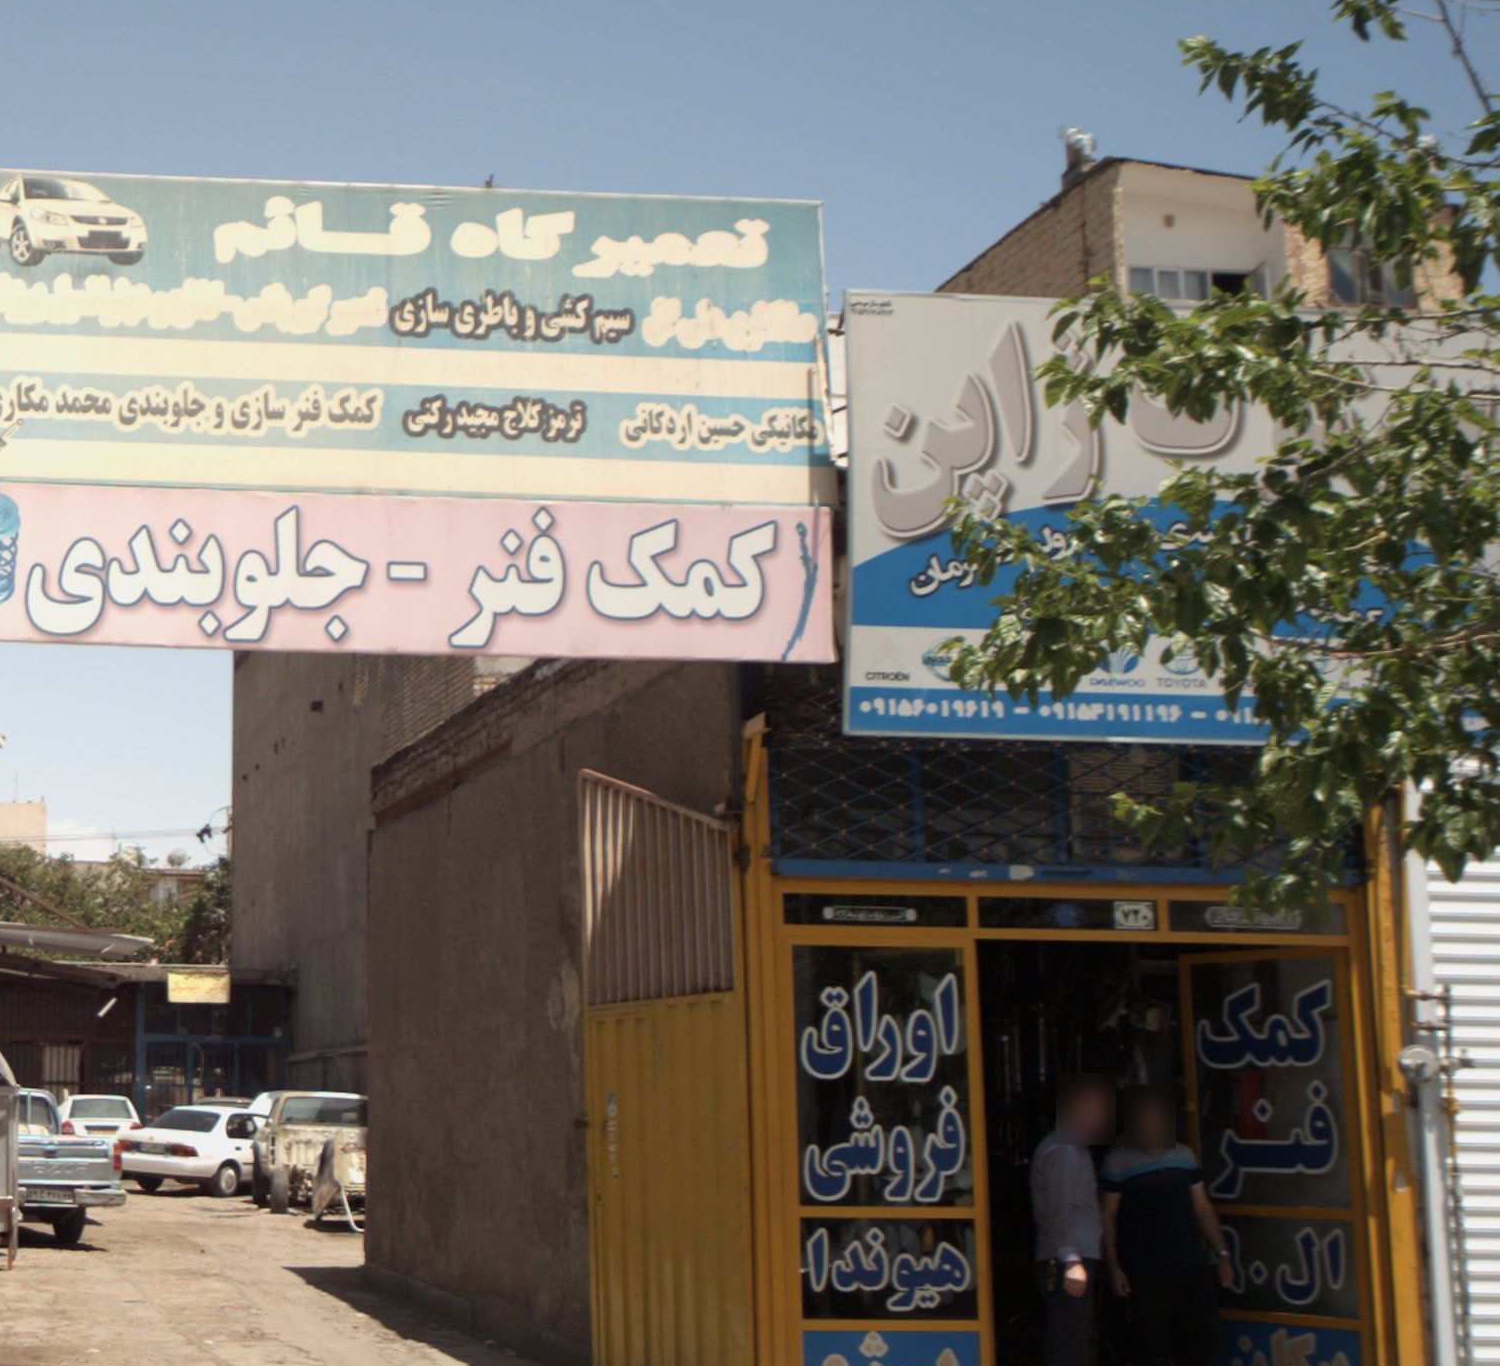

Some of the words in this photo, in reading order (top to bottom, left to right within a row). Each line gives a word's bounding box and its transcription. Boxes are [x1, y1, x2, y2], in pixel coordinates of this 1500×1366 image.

[572, 218, 770, 277] تعمیر
[392, 290, 451, 334] سازی
[453, 292, 520, 338] باطری
[540, 295, 591, 339] کشی
[592, 308, 634, 341] سیم
[54, 387, 113, 417] محمد
[117, 386, 207, 430] جلوبندی
[229, 392, 286, 432] سازی
[291, 388, 324, 433] فنر
[327, 392, 379, 425] کمک
[455, 401, 502, 435] مجید
[697, 416, 747, 446] حسین
[750, 409, 820, 447] مکانیکی
[24, 504, 369, 644] جلوبندی
[449, 507, 567, 649] فنر
[587, 518, 778, 622] کمک
[910, 555, 980, 596] رمان
[1155, 676, 1208, 690] TOYOTA
[801, 970, 960, 1084] اوراق
[1197, 977, 1333, 1069] کمک
[803, 1084, 966, 1204] فروشی
[1209, 1080, 1339, 1200] فنر
[806, 1227, 972, 1312] هیوندا
[1276, 1227, 1346, 1306] ال
